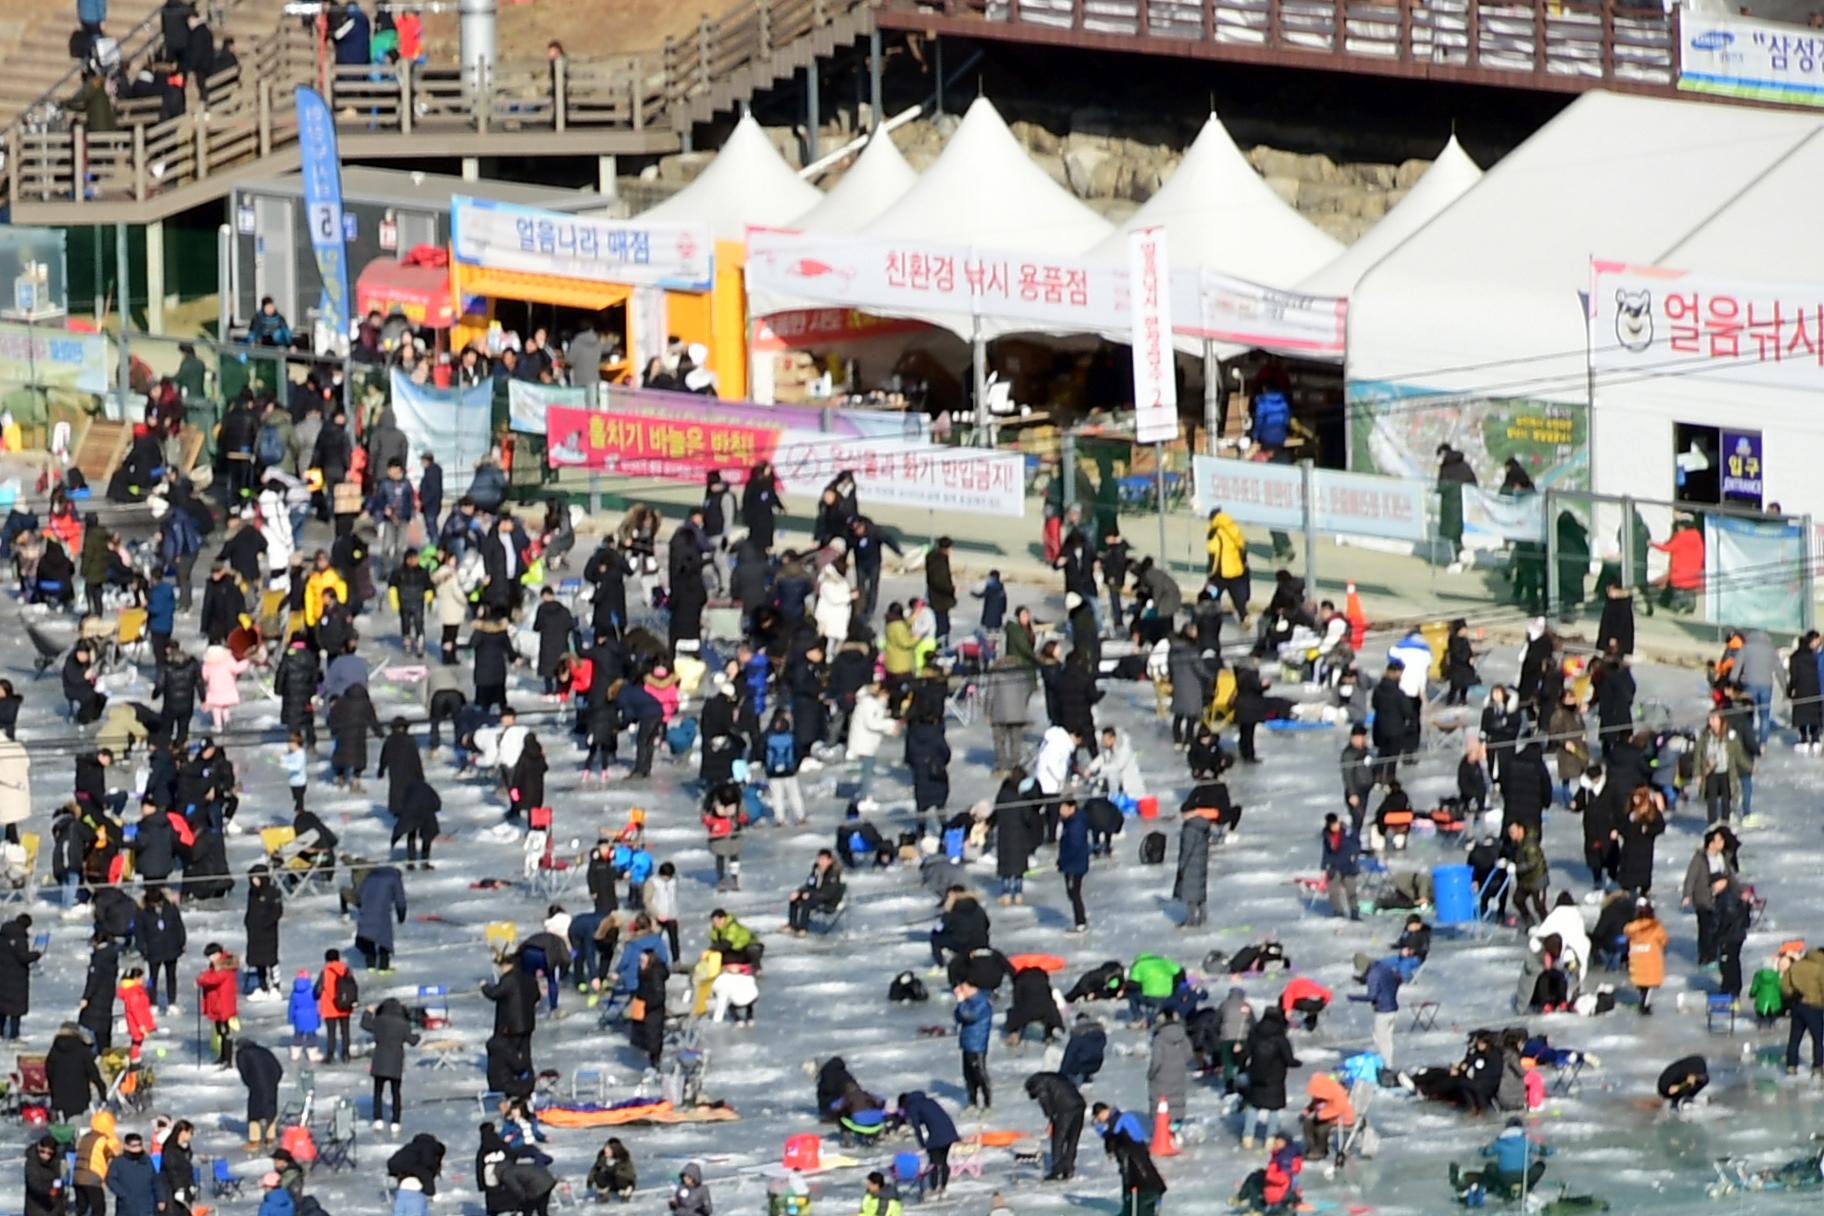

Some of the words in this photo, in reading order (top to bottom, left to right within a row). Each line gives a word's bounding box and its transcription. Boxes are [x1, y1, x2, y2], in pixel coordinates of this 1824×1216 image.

[515, 216, 599, 261] 얼음나라
[607, 229, 652, 264] 매점
[885, 249, 955, 292] 친환경
[964, 259, 1009, 298] 낚시
[1019, 262, 1089, 306] 용품점
[1663, 291, 1824, 367] 얼음낚시
[1151, 389, 1162, 408] 2
[588, 414, 644, 454] 훌치기
[711, 430, 757, 466] 반칙!
[902, 450, 937, 485] 화기
[941, 457, 1015, 494] 반입금지!
[1728, 454, 1760, 479] 입구
